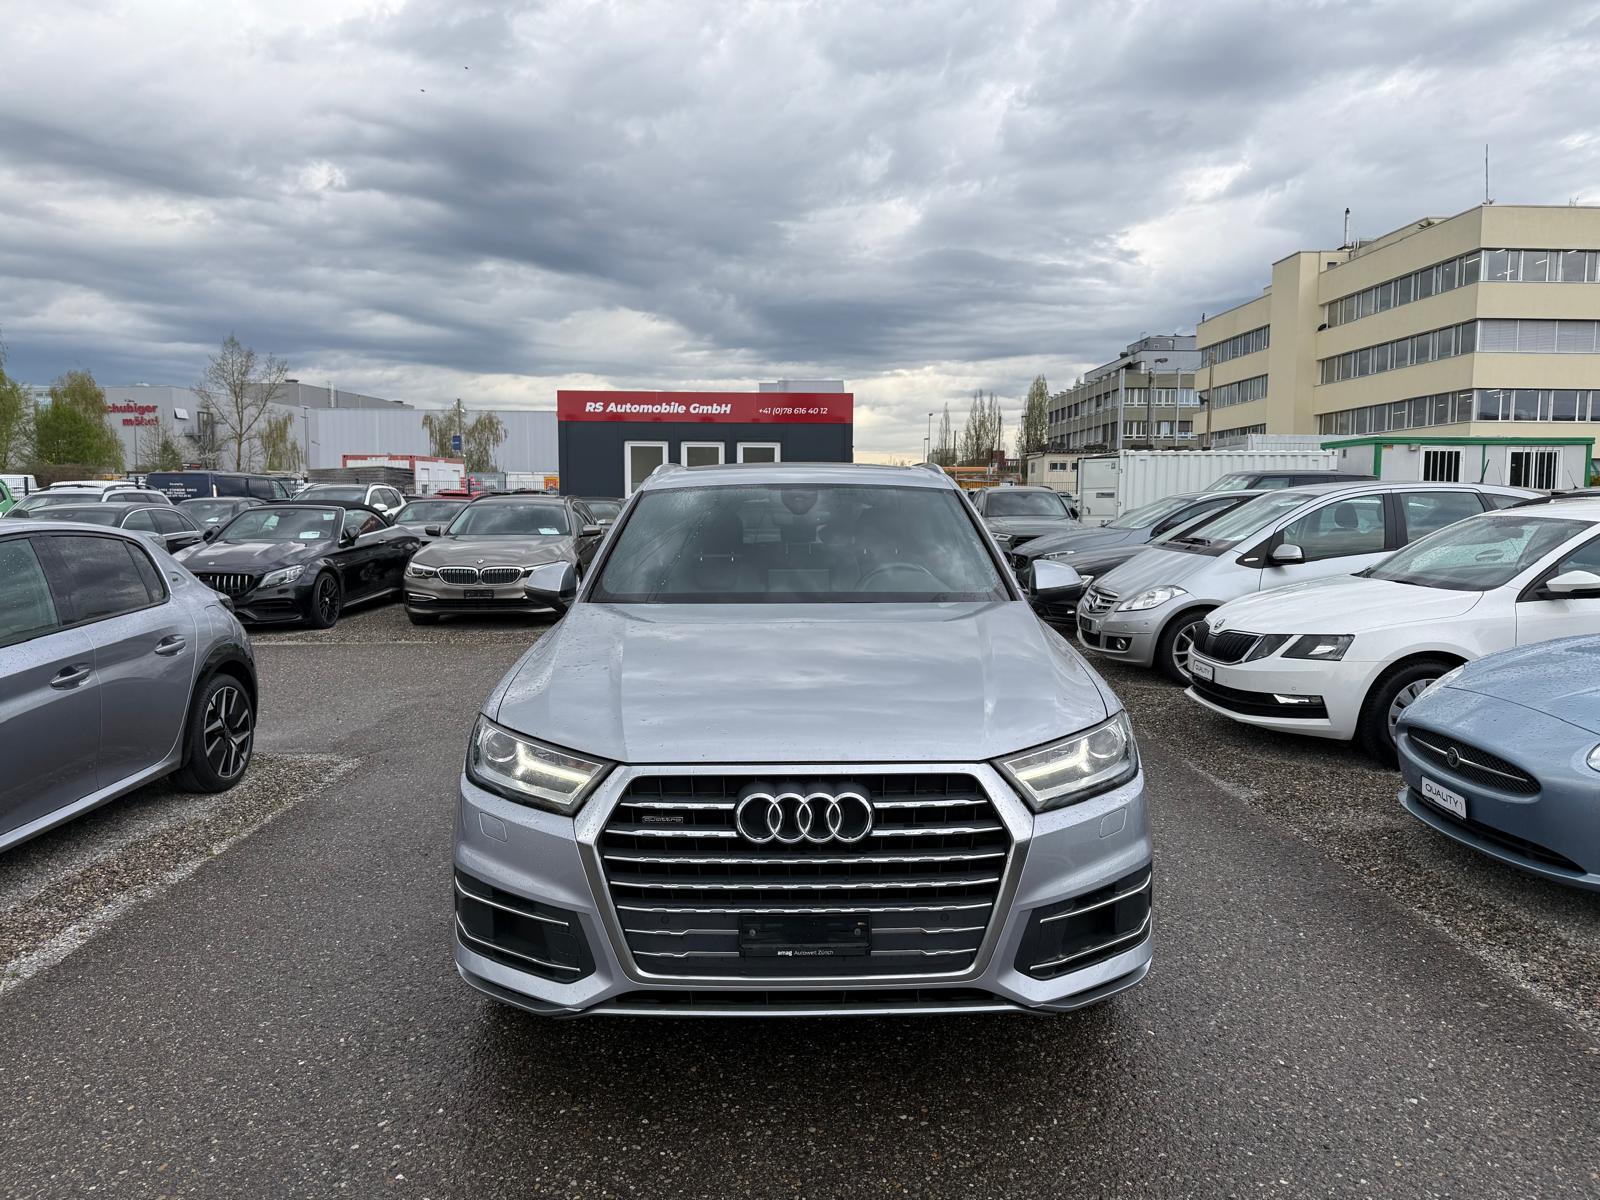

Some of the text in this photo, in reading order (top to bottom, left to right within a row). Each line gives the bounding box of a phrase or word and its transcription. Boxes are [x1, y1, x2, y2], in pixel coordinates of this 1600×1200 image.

[106, 403, 158, 415] chubiger
[585, 402, 732, 414] RS Automobile GmbH
[772, 407, 792, 415] (0)78
[1425, 783, 1459, 807] QUALITY
